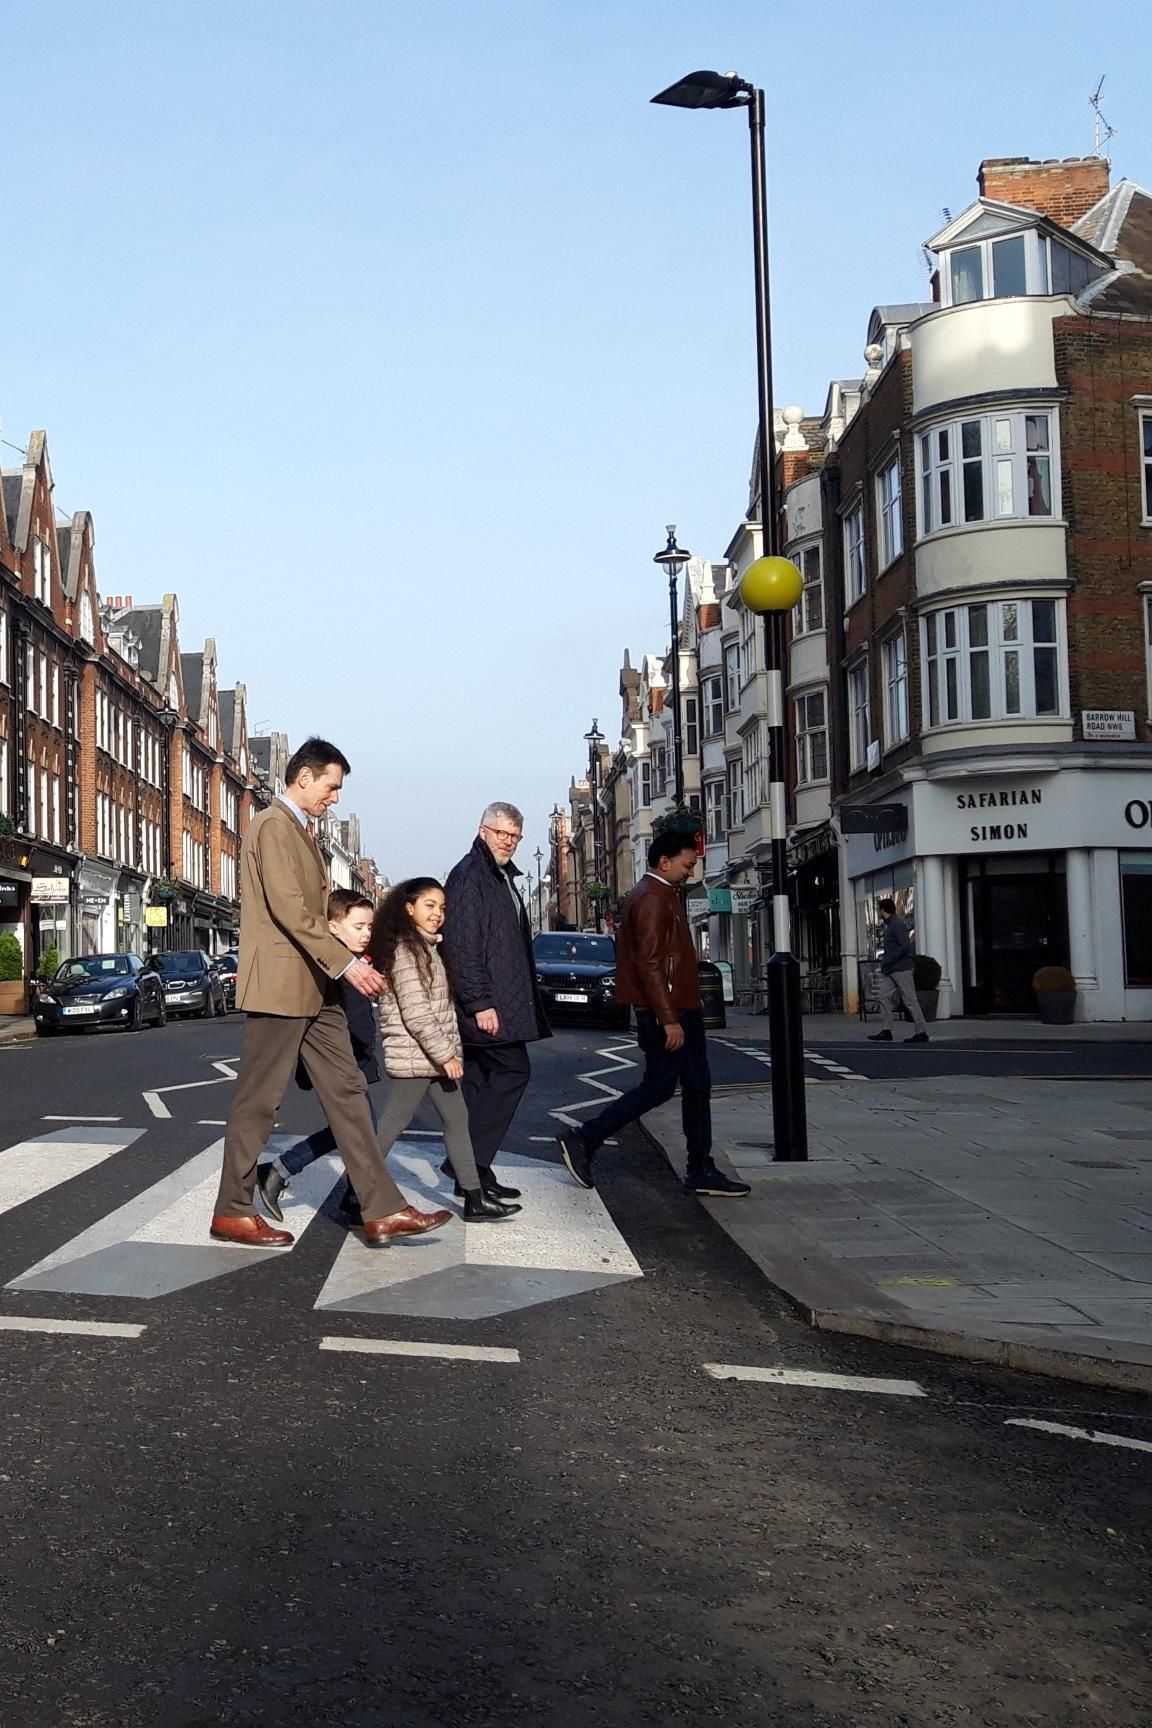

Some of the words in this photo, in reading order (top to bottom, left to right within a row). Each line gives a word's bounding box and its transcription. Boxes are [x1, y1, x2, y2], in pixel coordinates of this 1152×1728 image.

[1086, 713, 1115, 721] BARROW
[1117, 713, 1132, 722] HILL
[1086, 722, 1105, 730] ROAD
[956, 789, 1043, 809] SAFARIAN
[1124, 800, 1152, 829] O
[970, 824, 1029, 841] SIMON
